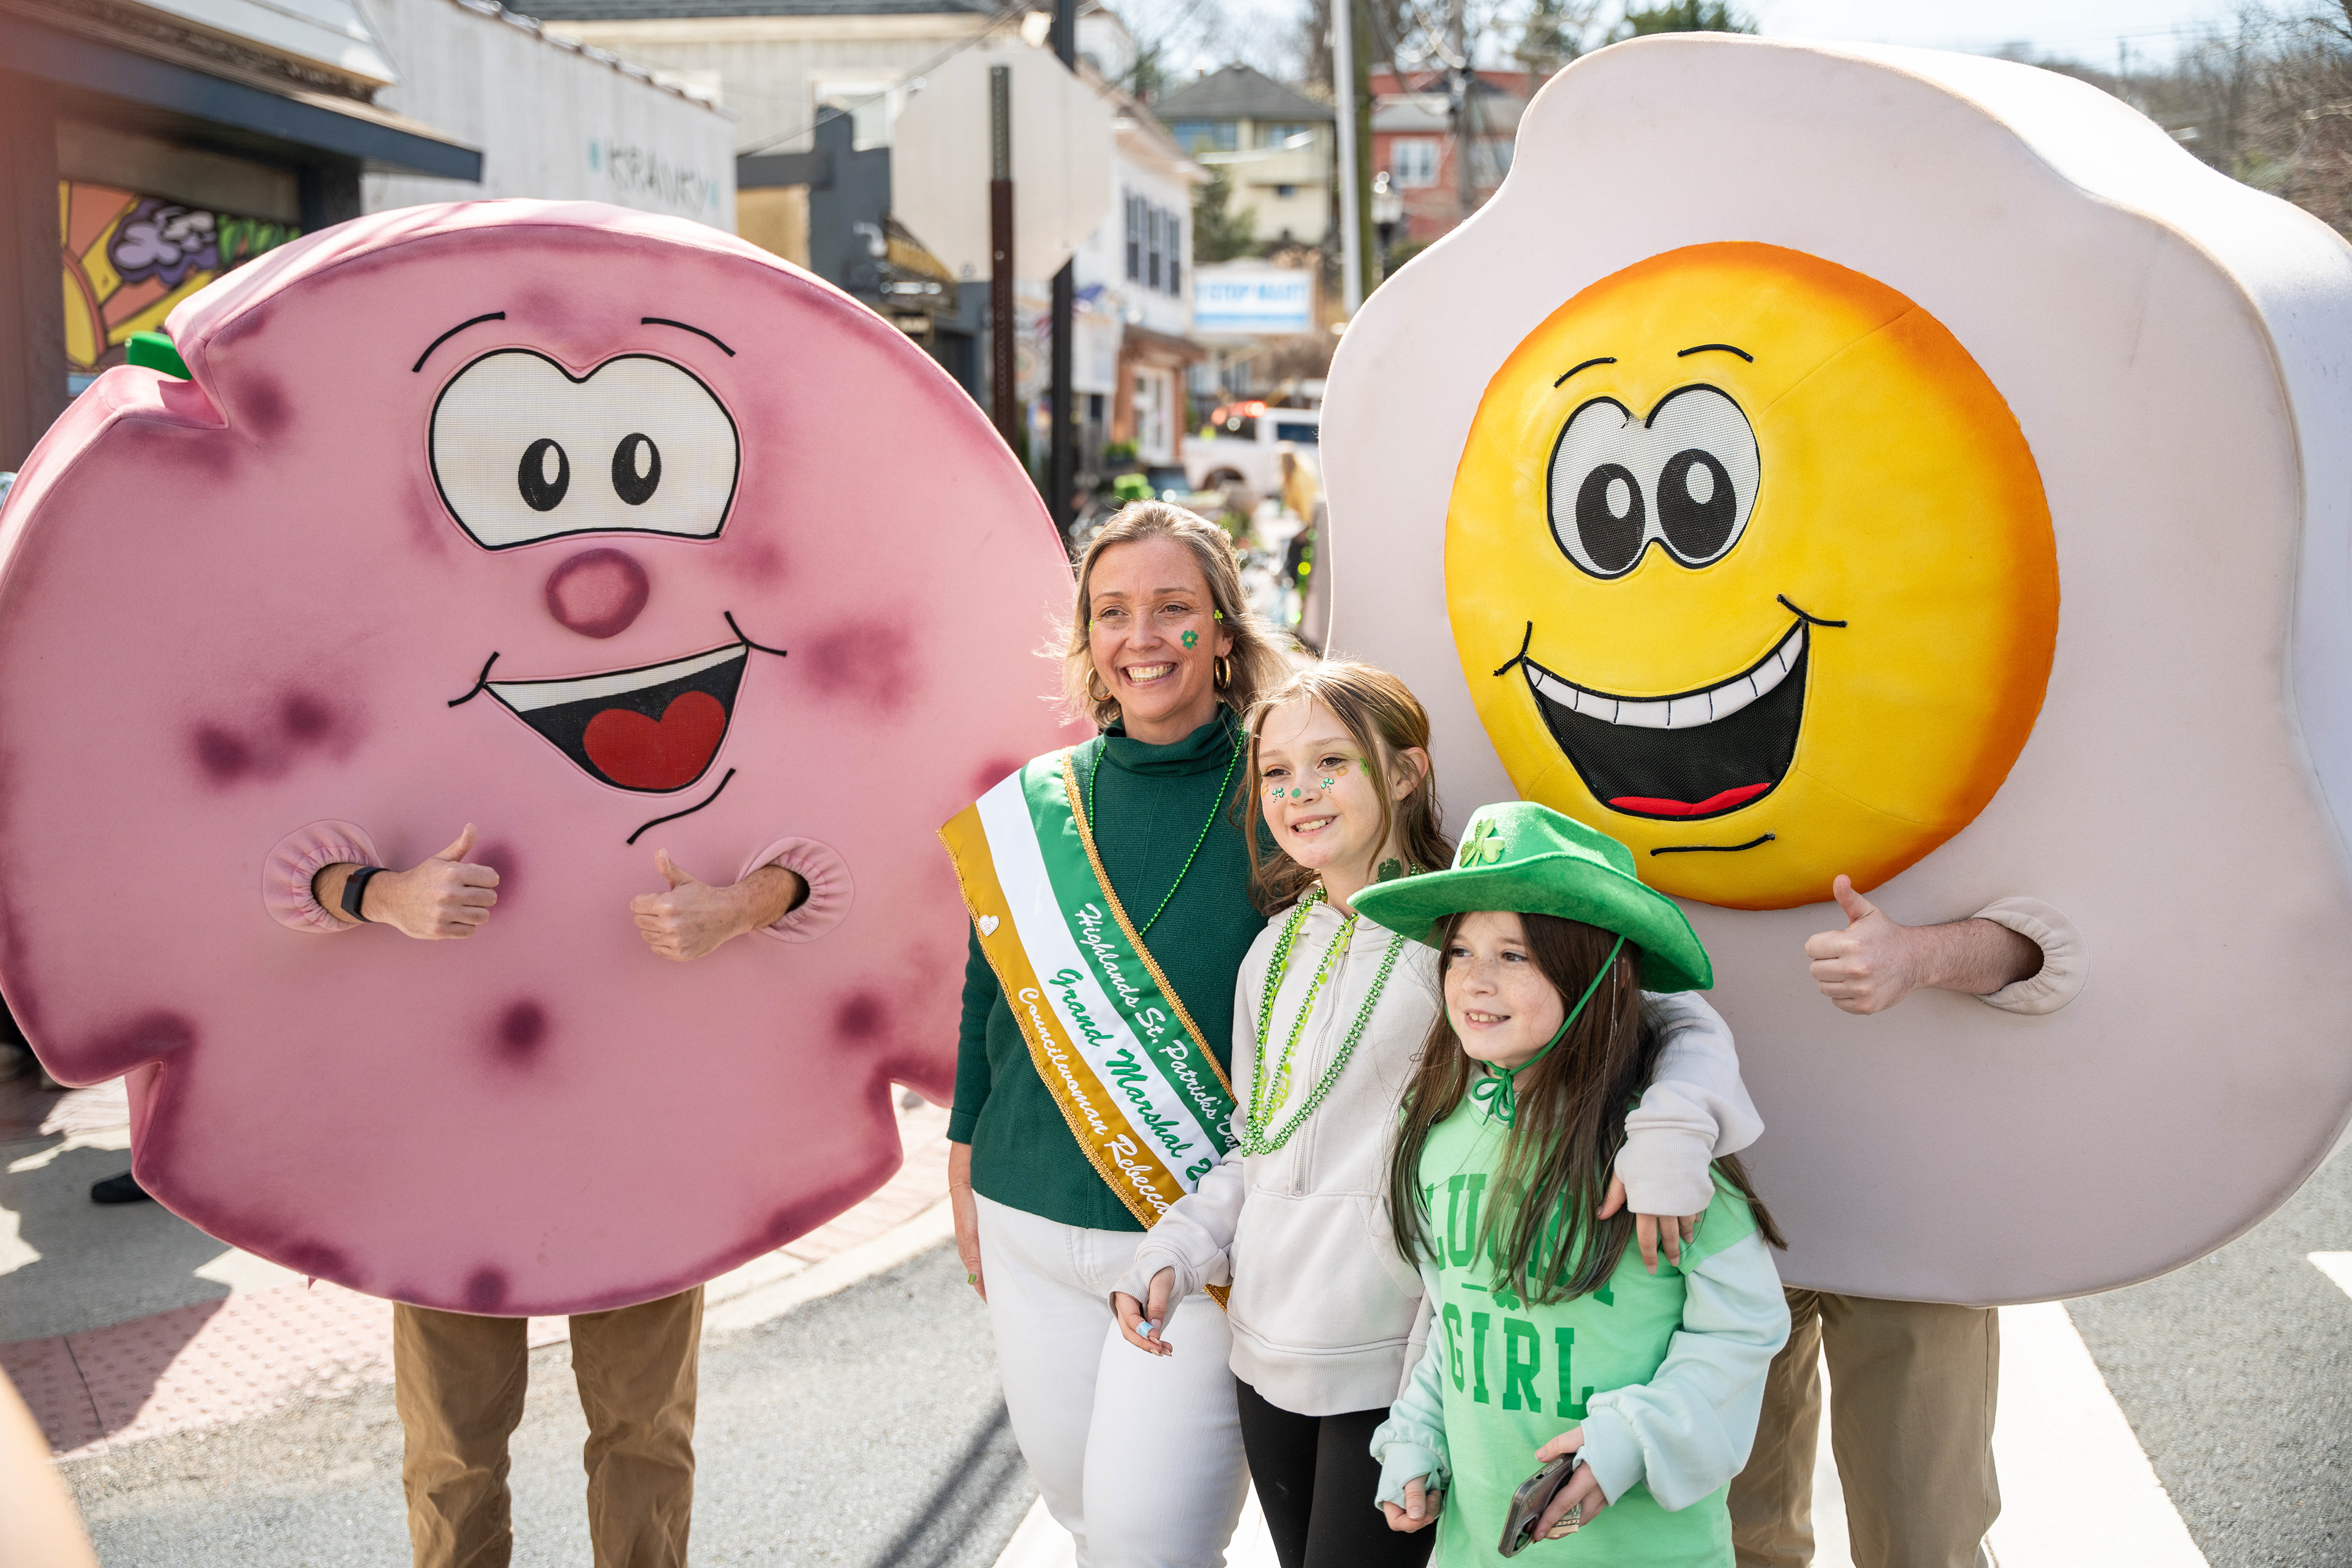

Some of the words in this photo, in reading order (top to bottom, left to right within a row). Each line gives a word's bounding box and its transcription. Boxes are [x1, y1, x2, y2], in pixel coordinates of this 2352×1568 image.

[1018, 987, 1108, 1136] Councilwoman
[1103, 1133, 1172, 1216] Rebecca
[1049, 968, 1115, 1047] Grand
[1105, 1048, 1193, 1159] Marshal
[1075, 903, 1140, 1008] Highlands
[1135, 1007, 1167, 1045] St.
[1159, 1039, 1223, 1120] Patrick's
[1442, 1302, 1594, 1420] GIRL
